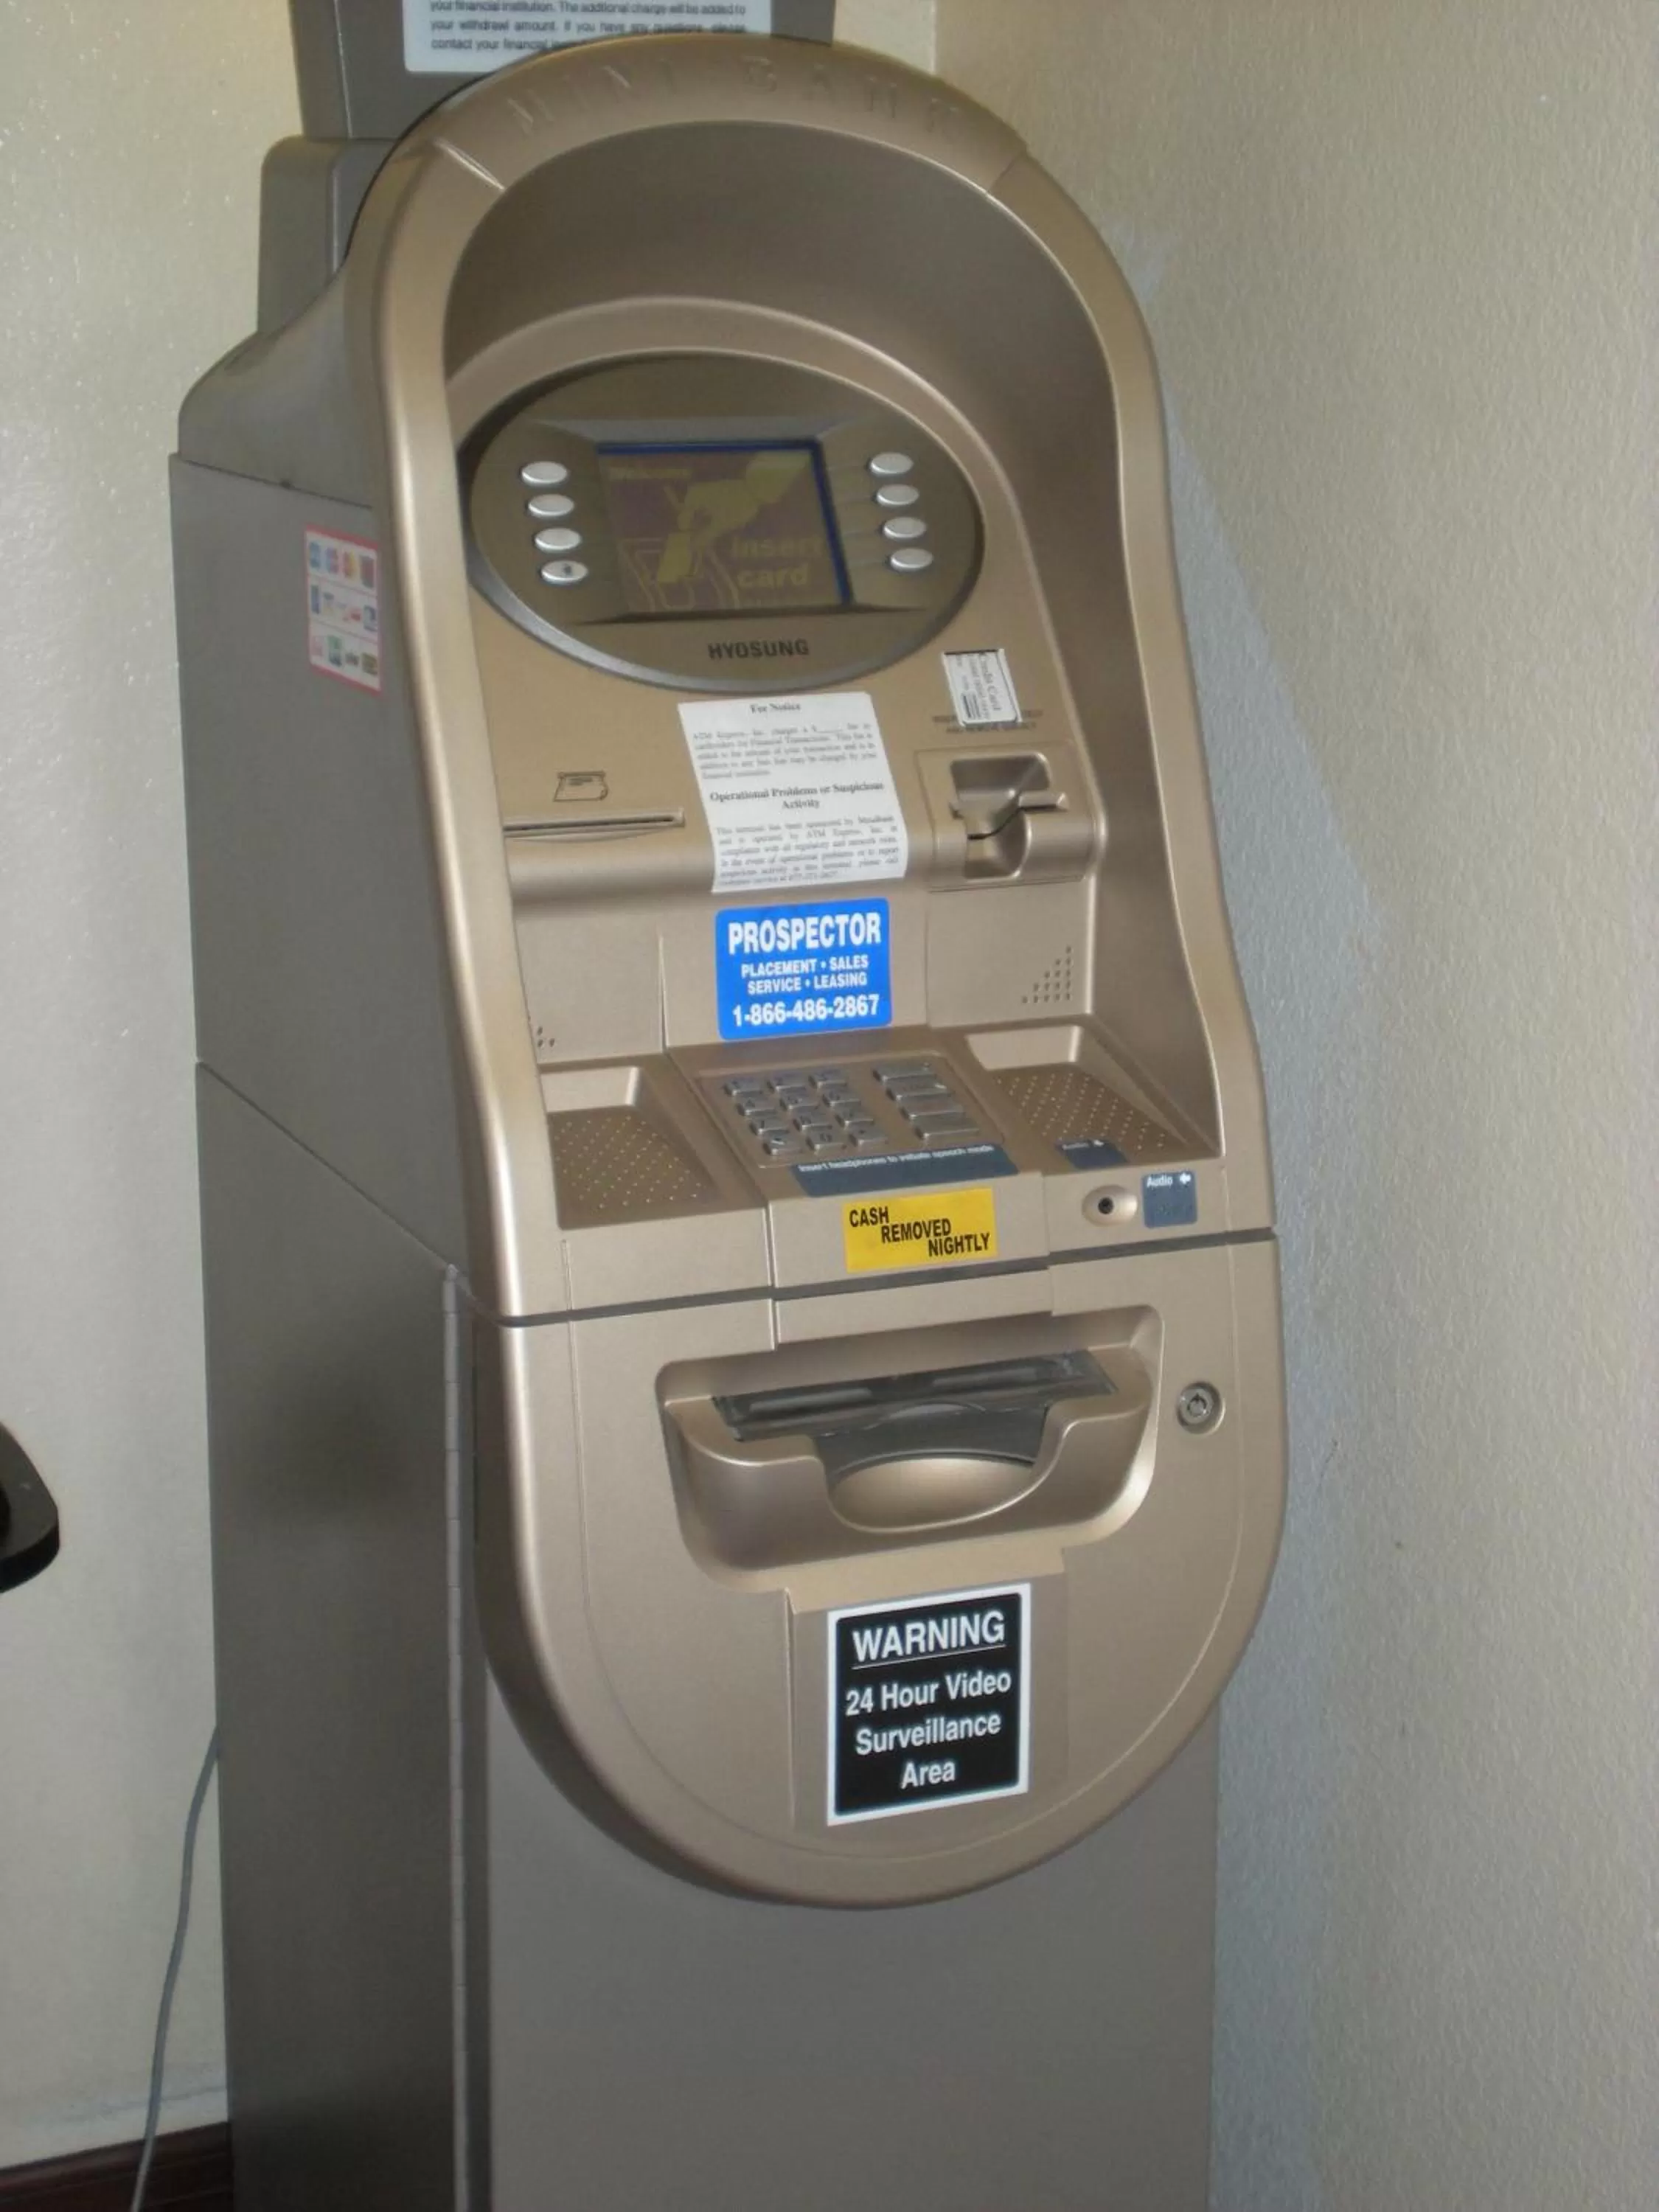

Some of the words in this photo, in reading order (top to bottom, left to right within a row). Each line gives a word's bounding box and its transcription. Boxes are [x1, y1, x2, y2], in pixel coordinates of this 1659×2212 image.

[707, 639, 809, 660] HYOSUNG
[728, 912, 881, 956] PROSPECTOR
[741, 959, 817, 978] PLACEMENT
[829, 955, 869, 971] SALES
[747, 977, 802, 995] SERVICE
[813, 972, 867, 990] LEASING
[732, 994, 880, 1027] 1-866-486-2867
[1147, 1174, 1173, 1188] Audio
[849, 1206, 889, 1228] CASH
[881, 1218, 951, 1244] REMOVED
[928, 1232, 990, 1257] NIGHTLY
[852, 1610, 1006, 1663] WARNING
[845, 1686, 874, 1717] 24
[880, 1680, 939, 1711] Hour
[945, 1670, 1012, 1700] Video
[855, 1713, 1002, 1756] Surveillance
[900, 1759, 956, 1790] Area
